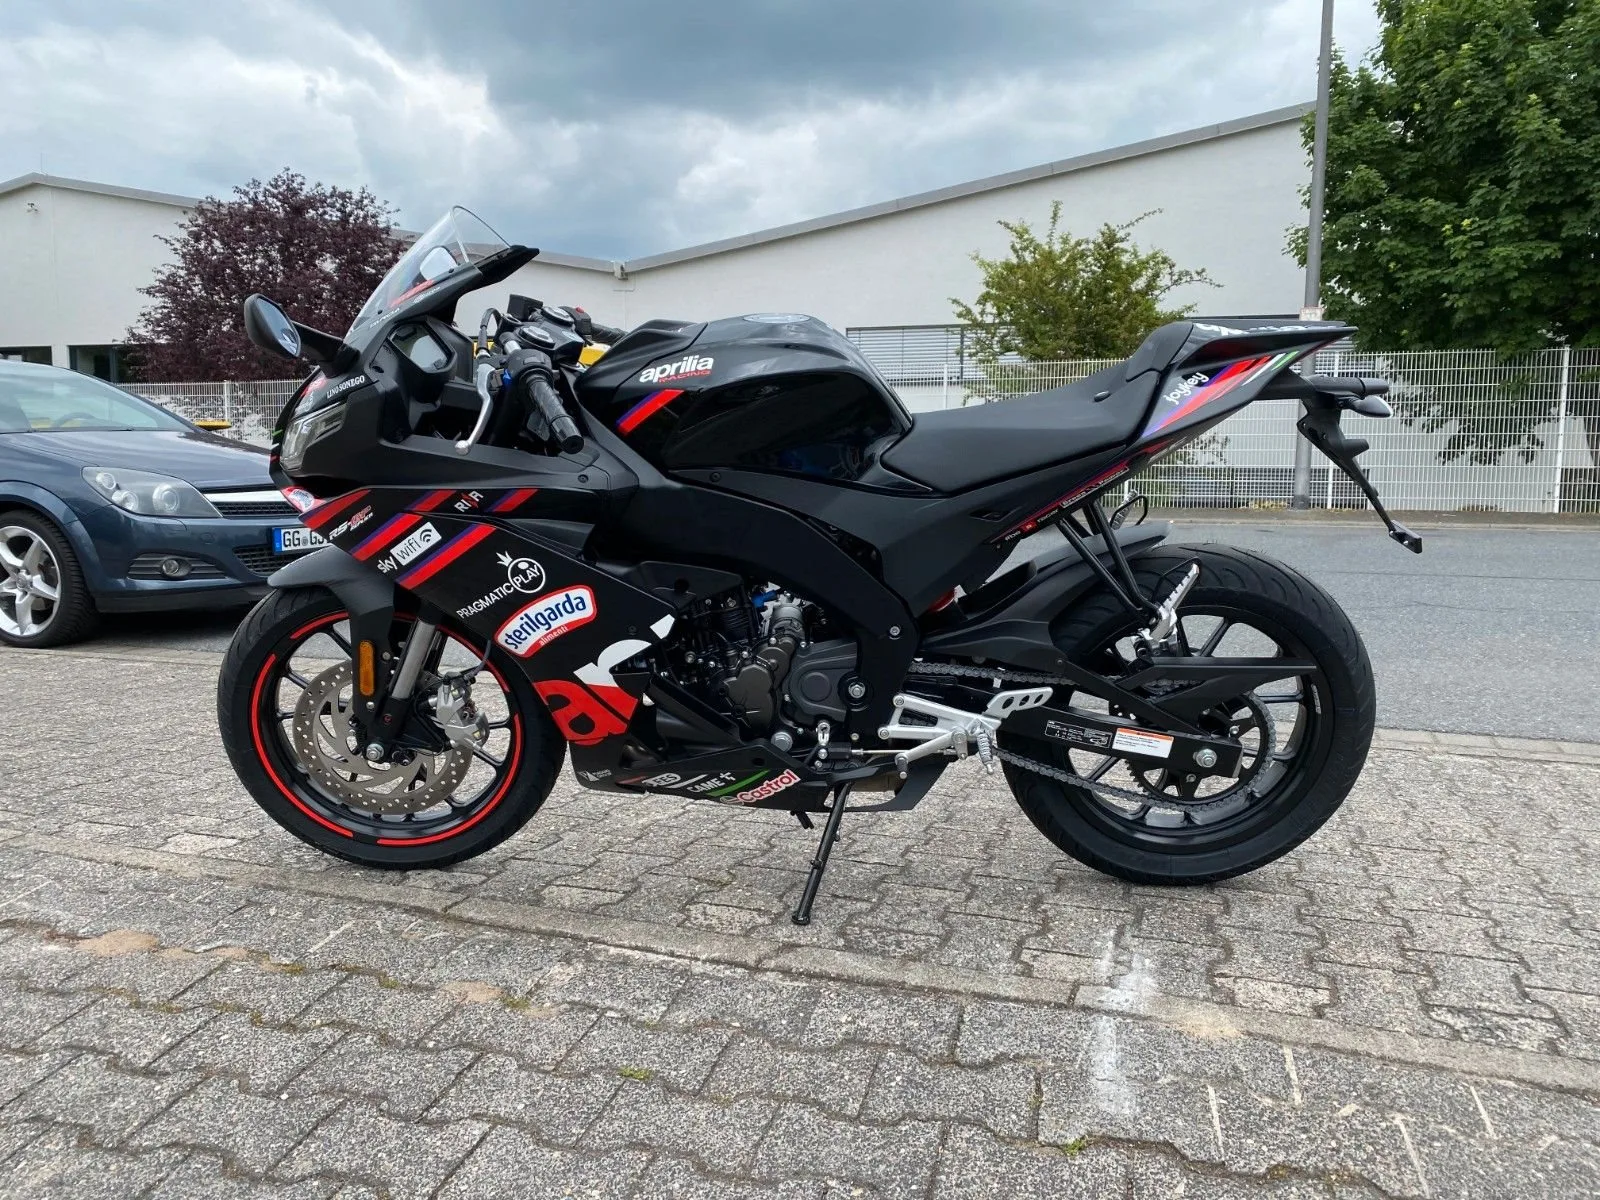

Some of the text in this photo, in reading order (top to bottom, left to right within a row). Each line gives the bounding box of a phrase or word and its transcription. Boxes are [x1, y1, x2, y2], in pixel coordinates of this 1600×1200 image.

[639, 355, 714, 383] aprilia
[659, 370, 712, 383] RACING
[326, 386, 339, 399] LINO
[338, 375, 365, 391] SONEGO
[1163, 372, 1209, 405] joykey
[283, 530, 300, 547] GG
[377, 537, 421, 574] sky wifi
[456, 565, 541, 619] PRAGMATIC PLAY
[504, 593, 587, 650] sterilgarda
[539, 625, 568, 647] alimenti
[738, 769, 799, 804] Castrol
